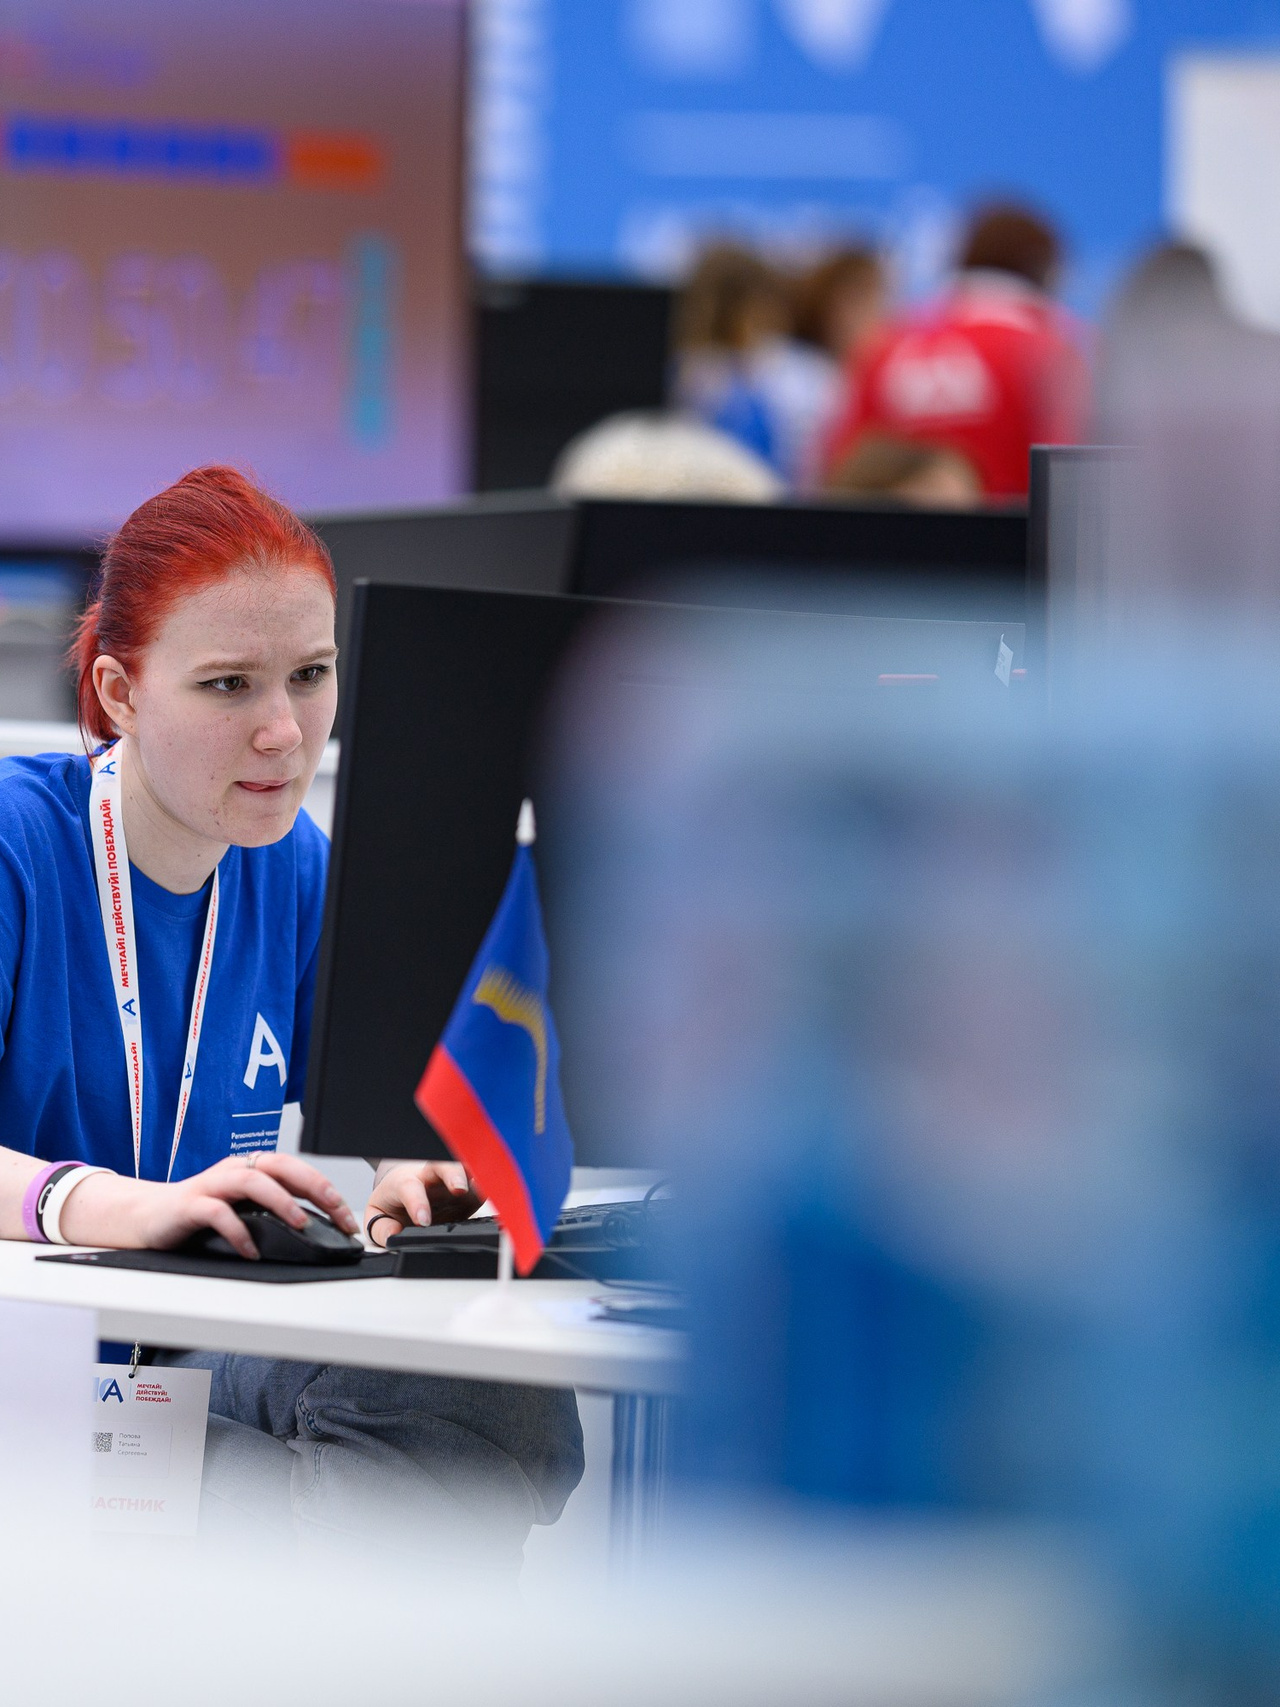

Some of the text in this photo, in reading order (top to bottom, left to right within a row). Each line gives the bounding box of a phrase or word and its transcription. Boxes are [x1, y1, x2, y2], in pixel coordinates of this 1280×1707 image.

[100, 799, 129, 988] МЕЧТАЙ! ДЕЙСТВУЙ! ПОБЕЖДАЙ!
[130, 1042, 140, 1114] ПОБЕЖДАЙ!
